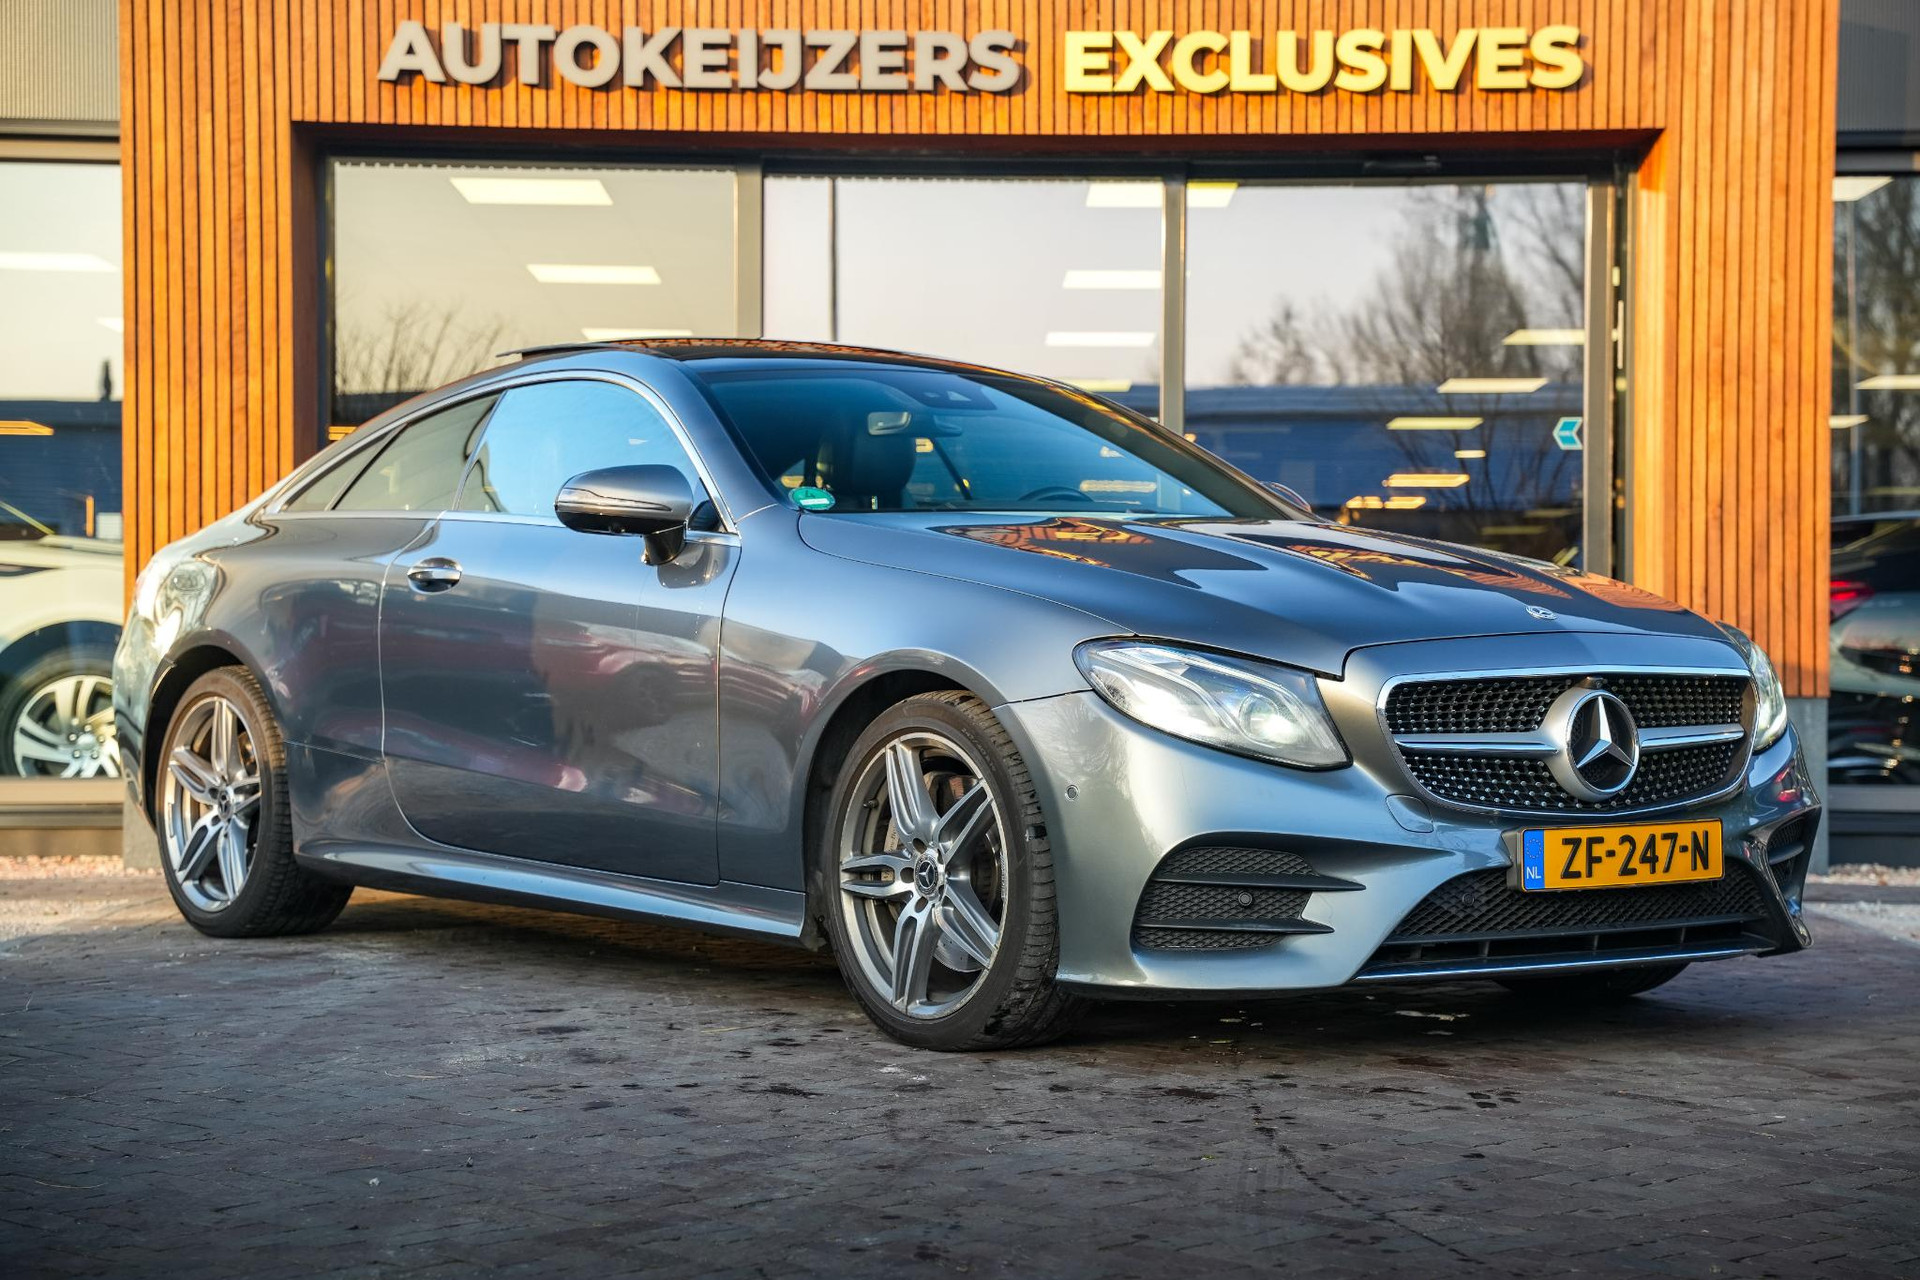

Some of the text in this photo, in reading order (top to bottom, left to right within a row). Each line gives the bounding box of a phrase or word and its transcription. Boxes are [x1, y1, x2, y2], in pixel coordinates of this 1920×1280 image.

[377, 20, 1584, 93] AUTOKEIJZERS EXCLUSIVES
[1526, 866, 1541, 879] NL
[1560, 830, 1709, 879] ZF-247-N
